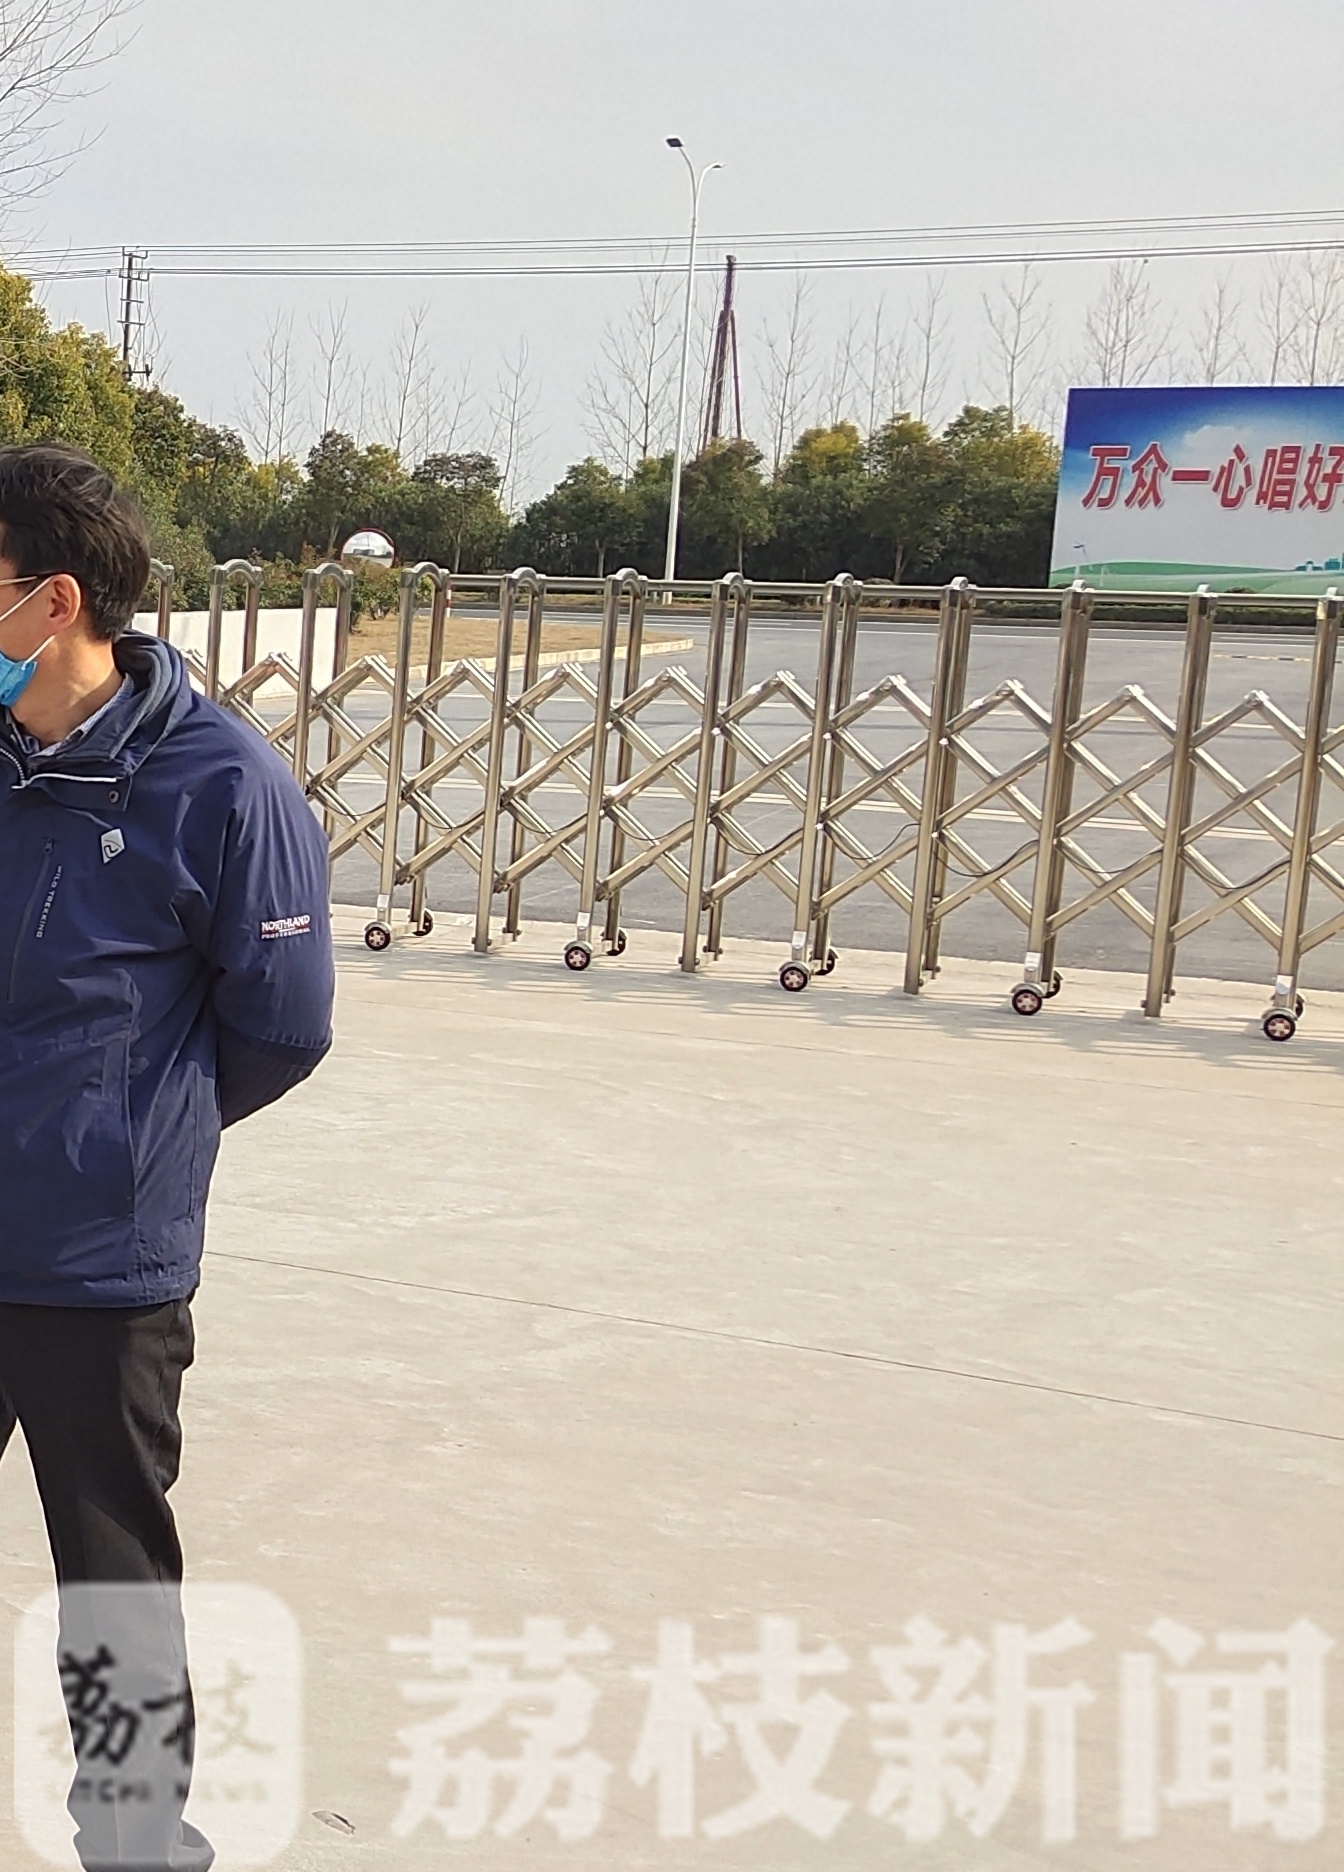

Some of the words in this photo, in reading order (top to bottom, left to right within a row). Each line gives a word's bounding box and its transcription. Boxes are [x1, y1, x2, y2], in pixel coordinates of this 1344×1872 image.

[1080, 441, 1344, 512] 万众一心唱好
[50, 864, 62, 888] WILD
[261, 914, 311, 933] NORTHLAND
